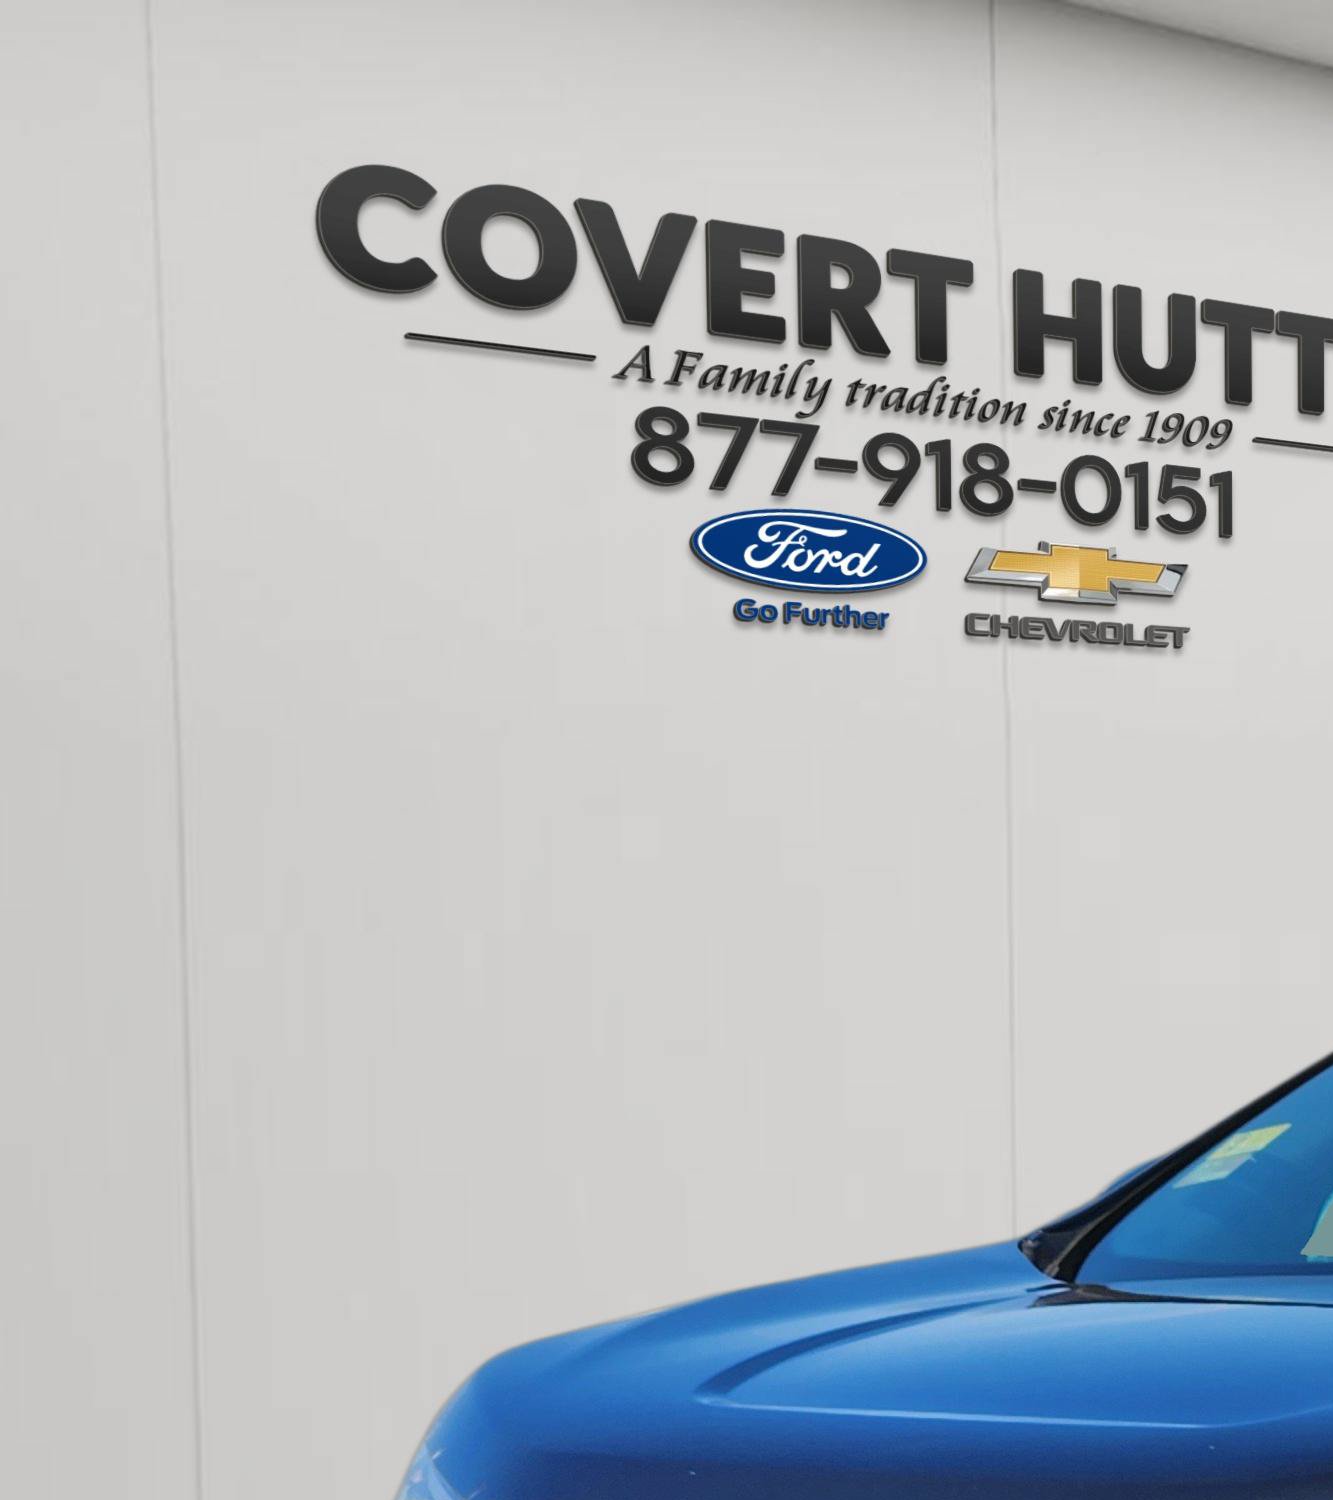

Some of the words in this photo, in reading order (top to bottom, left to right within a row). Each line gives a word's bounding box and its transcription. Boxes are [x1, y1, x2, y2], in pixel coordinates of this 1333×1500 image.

[315, 164, 974, 367] COVERT
[612, 345, 655, 384] A
[663, 349, 833, 420] Family
[845, 375, 1027, 427] tradition
[1037, 400, 1131, 439] since
[1138, 410, 1233, 450] 1909
[630, 406, 1233, 540] 877-918-0151
[743, 520, 881, 579] Ford
[732, 598, 779, 624] Go
[782, 601, 891, 631] Further
[964, 612, 1191, 650] CHEVROLET
